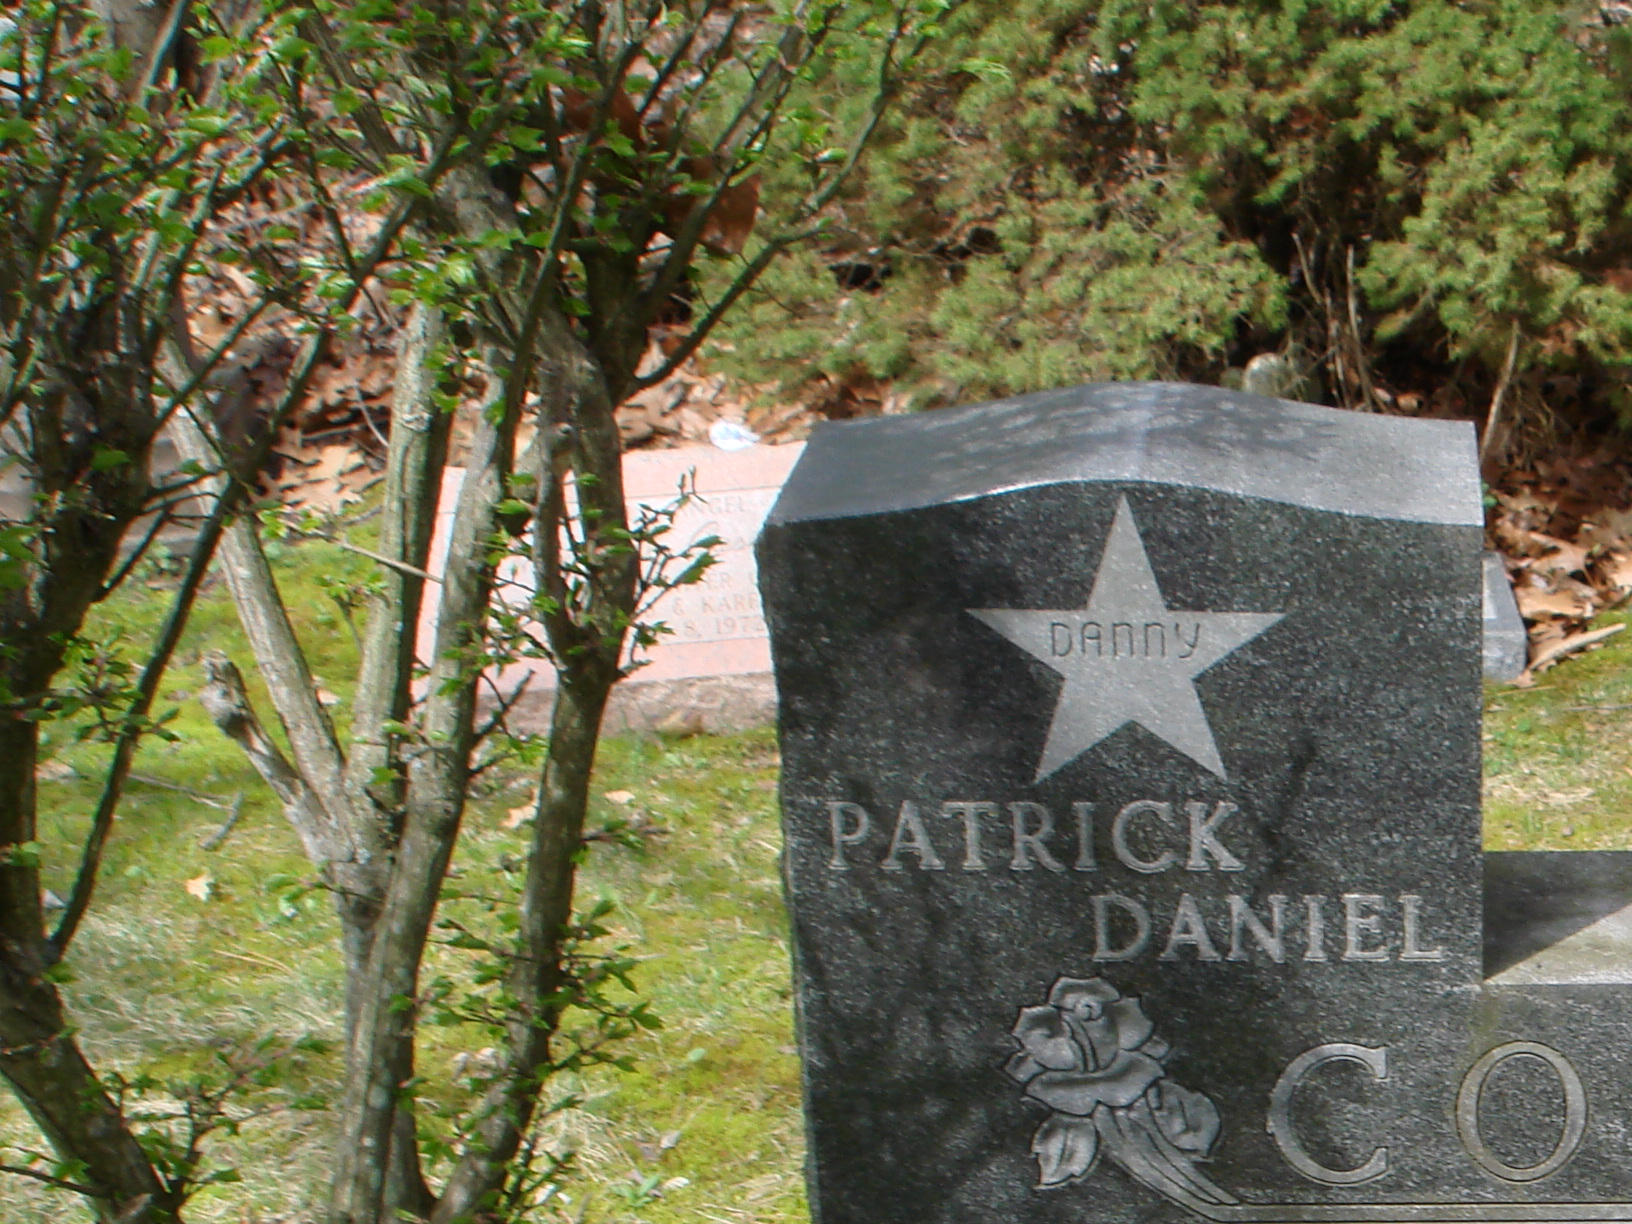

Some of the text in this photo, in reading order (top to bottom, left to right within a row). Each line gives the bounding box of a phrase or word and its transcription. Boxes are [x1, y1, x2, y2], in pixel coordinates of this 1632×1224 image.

[1050, 621, 1202, 658] DANNY
[827, 799, 1246, 873] PATRICK
[1090, 893, 1444, 963] DANIEL
